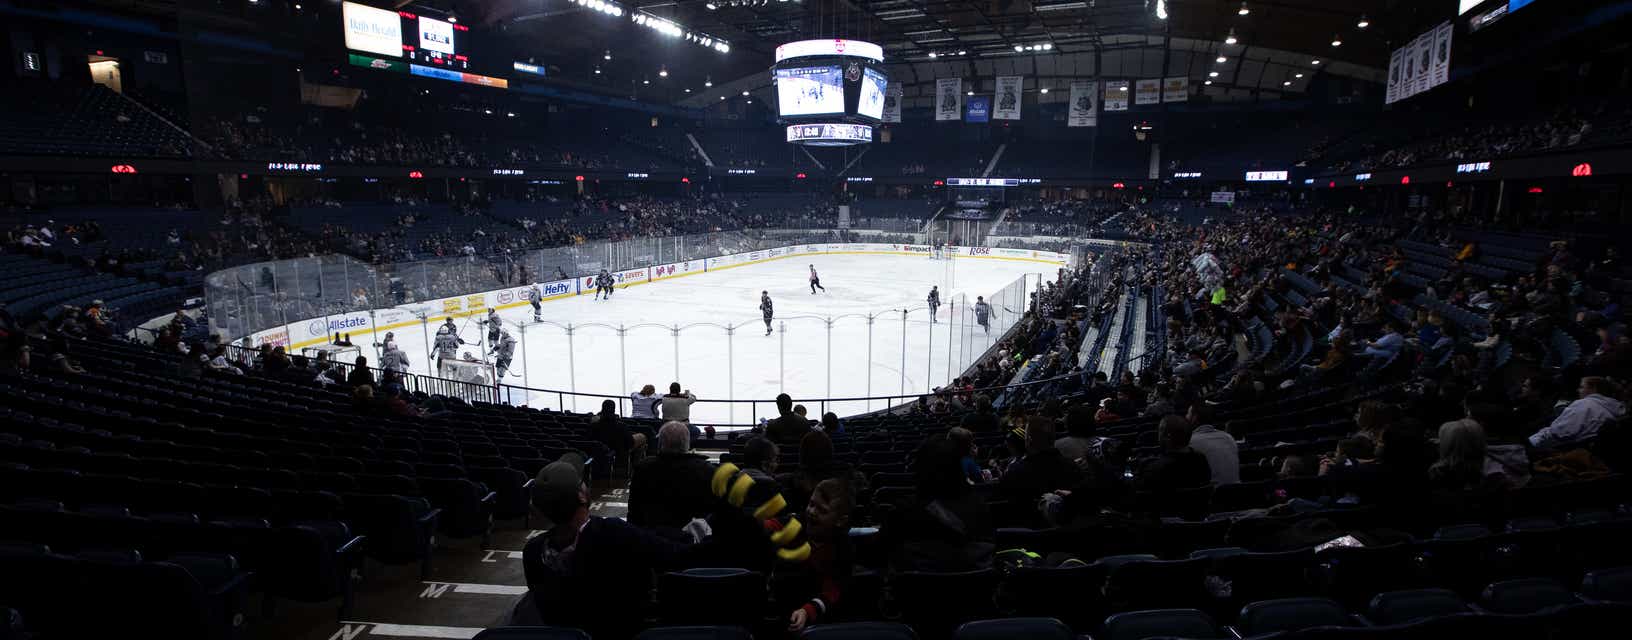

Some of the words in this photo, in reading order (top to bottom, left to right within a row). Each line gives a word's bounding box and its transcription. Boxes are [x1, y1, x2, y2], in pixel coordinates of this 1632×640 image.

[545, 284, 569, 294] Hefty
[329, 317, 366, 330] Allstate
[418, 583, 450, 599] M
[327, 623, 368, 640] N
